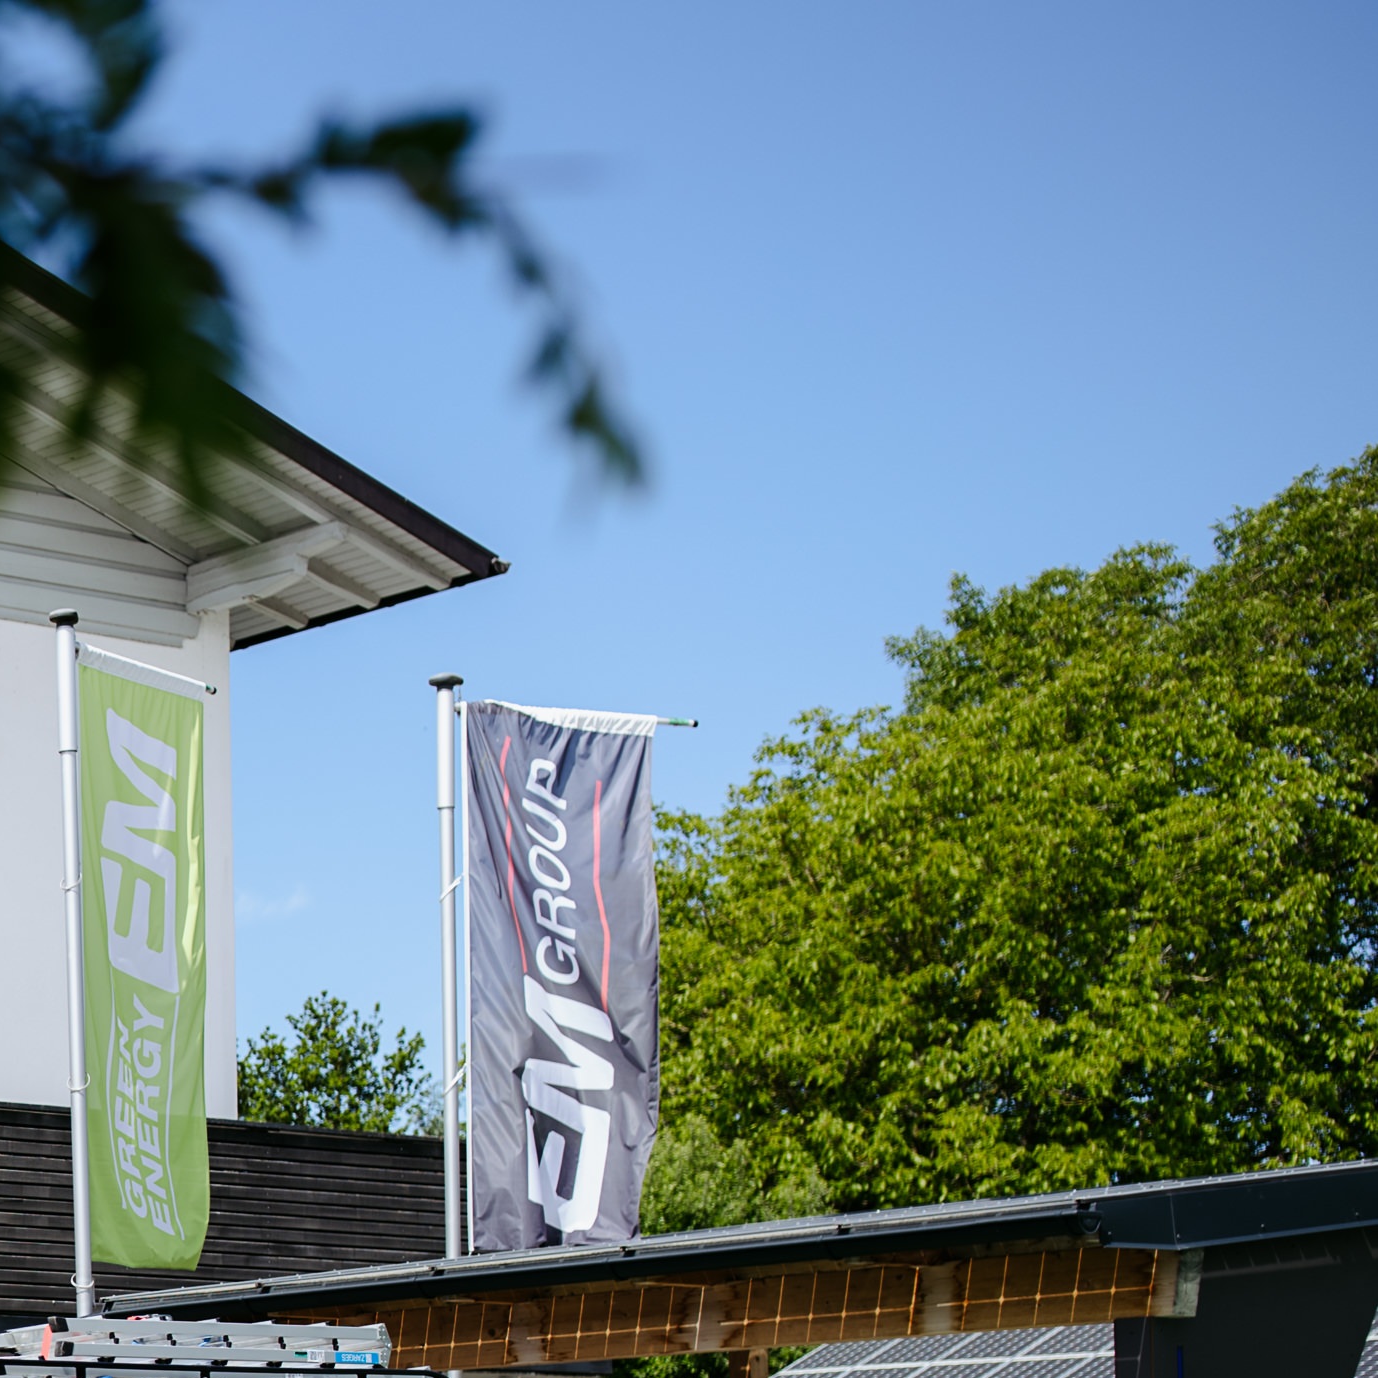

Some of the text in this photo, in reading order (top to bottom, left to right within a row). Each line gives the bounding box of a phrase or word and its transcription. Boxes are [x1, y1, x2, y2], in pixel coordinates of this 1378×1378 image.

[100, 707, 179, 994] EM
[115, 1014, 147, 1218] GREEN
[132, 993, 176, 1236] ENERGY
[521, 758, 614, 1233] EM GROUP
